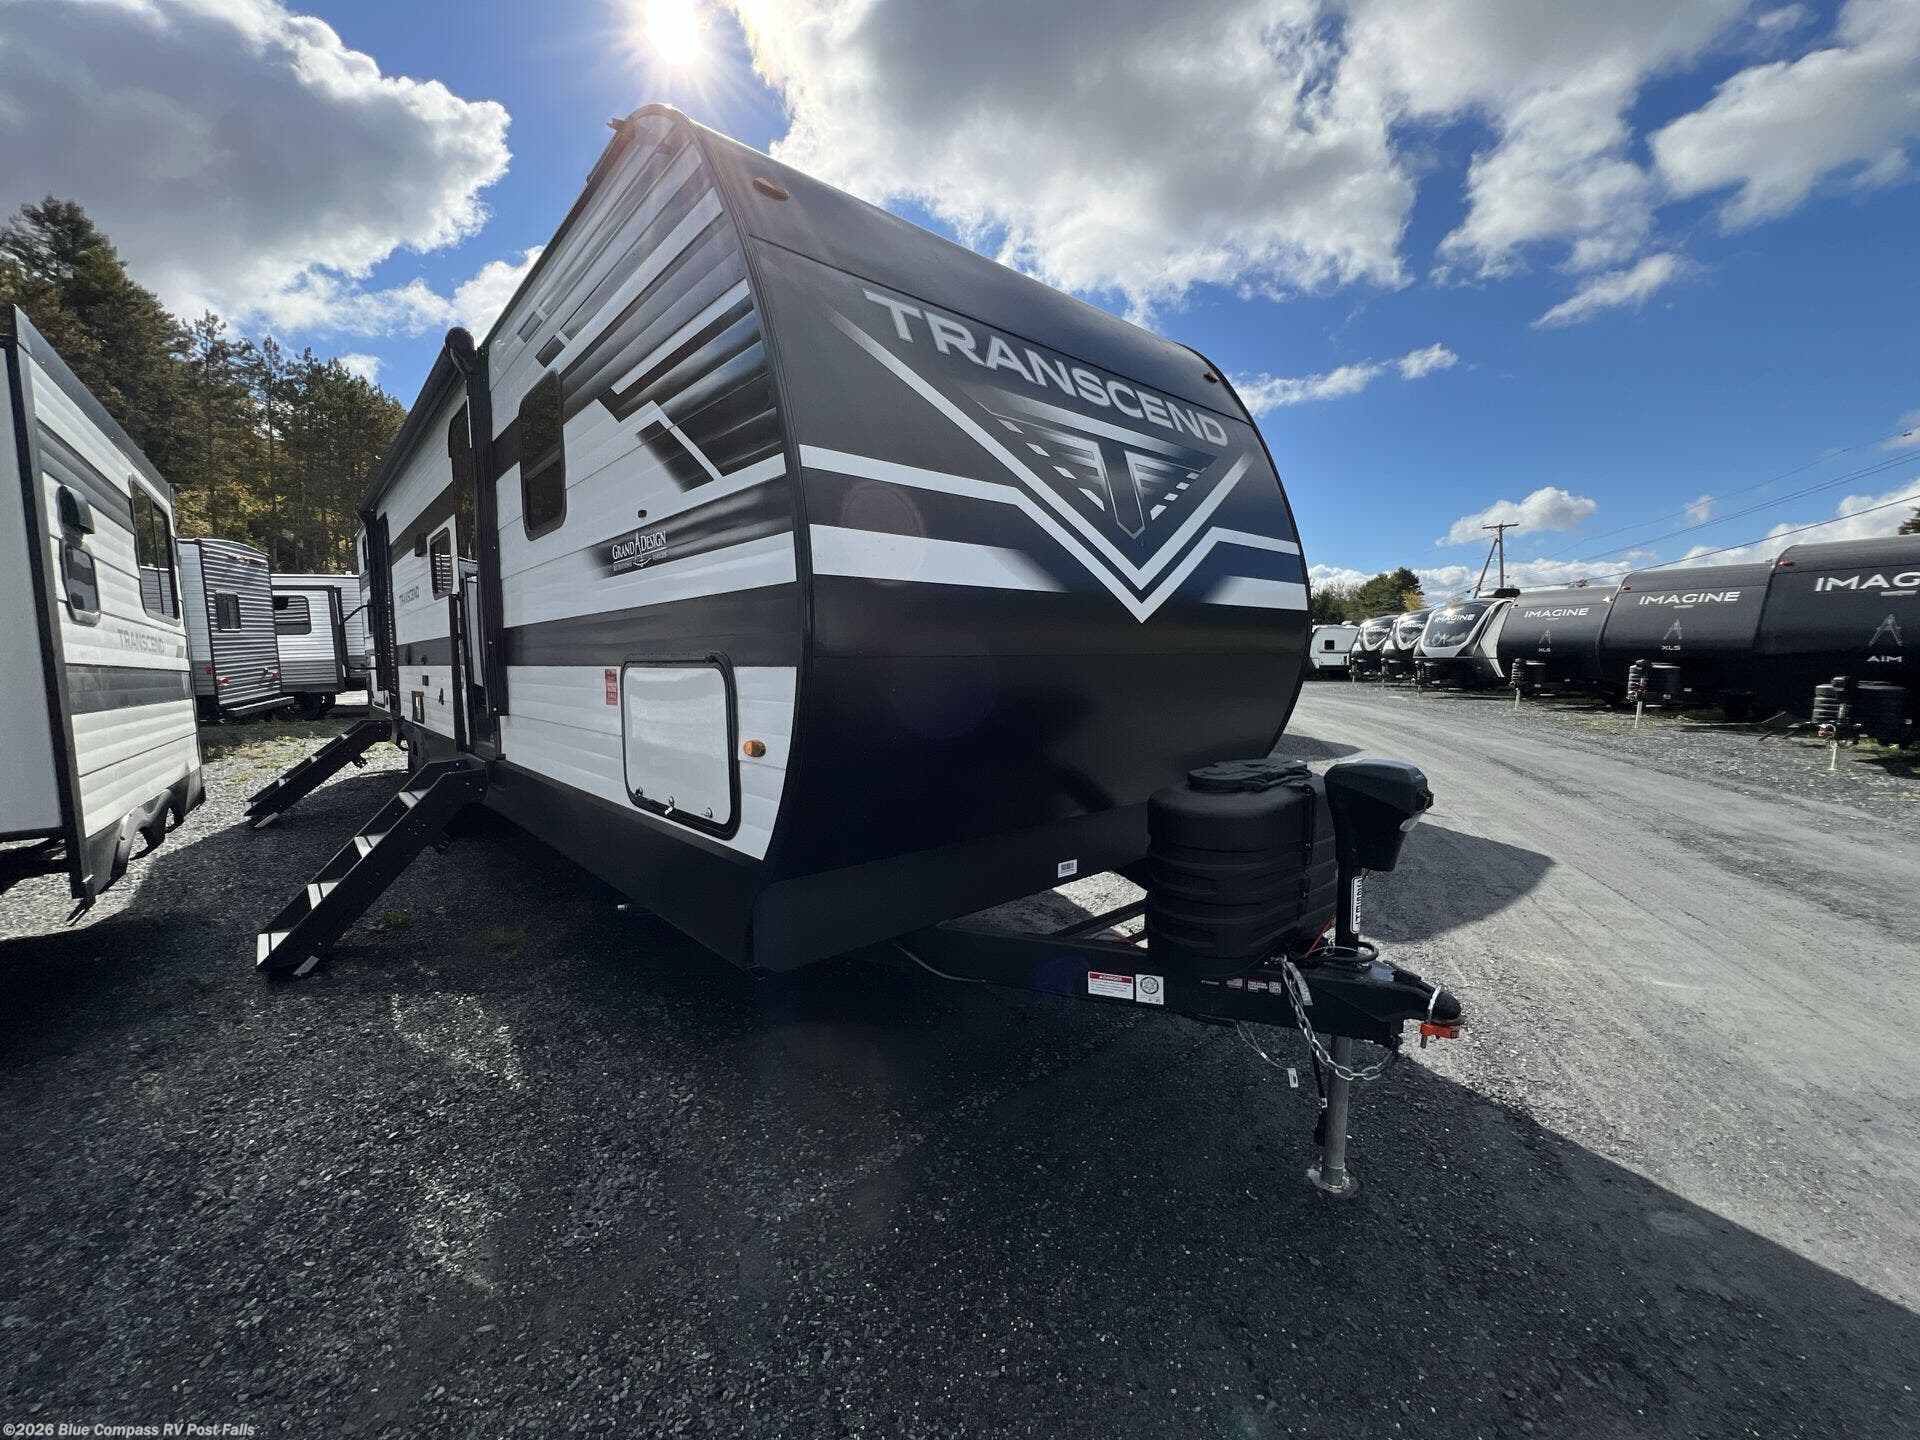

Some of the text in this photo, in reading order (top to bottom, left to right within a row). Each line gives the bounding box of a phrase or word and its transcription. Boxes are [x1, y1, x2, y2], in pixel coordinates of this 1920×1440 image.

[862, 288, 1229, 447] TRANSCEND
[612, 530, 667, 560] GRAND DESIGN
[1638, 591, 1741, 605] IMAGINE
[1434, 613, 1476, 624] IMAGINE
[1524, 607, 1590, 618] IMAGINE
[117, 628, 165, 655] TRANSCEND
[1866, 655, 1903, 663] AIM
